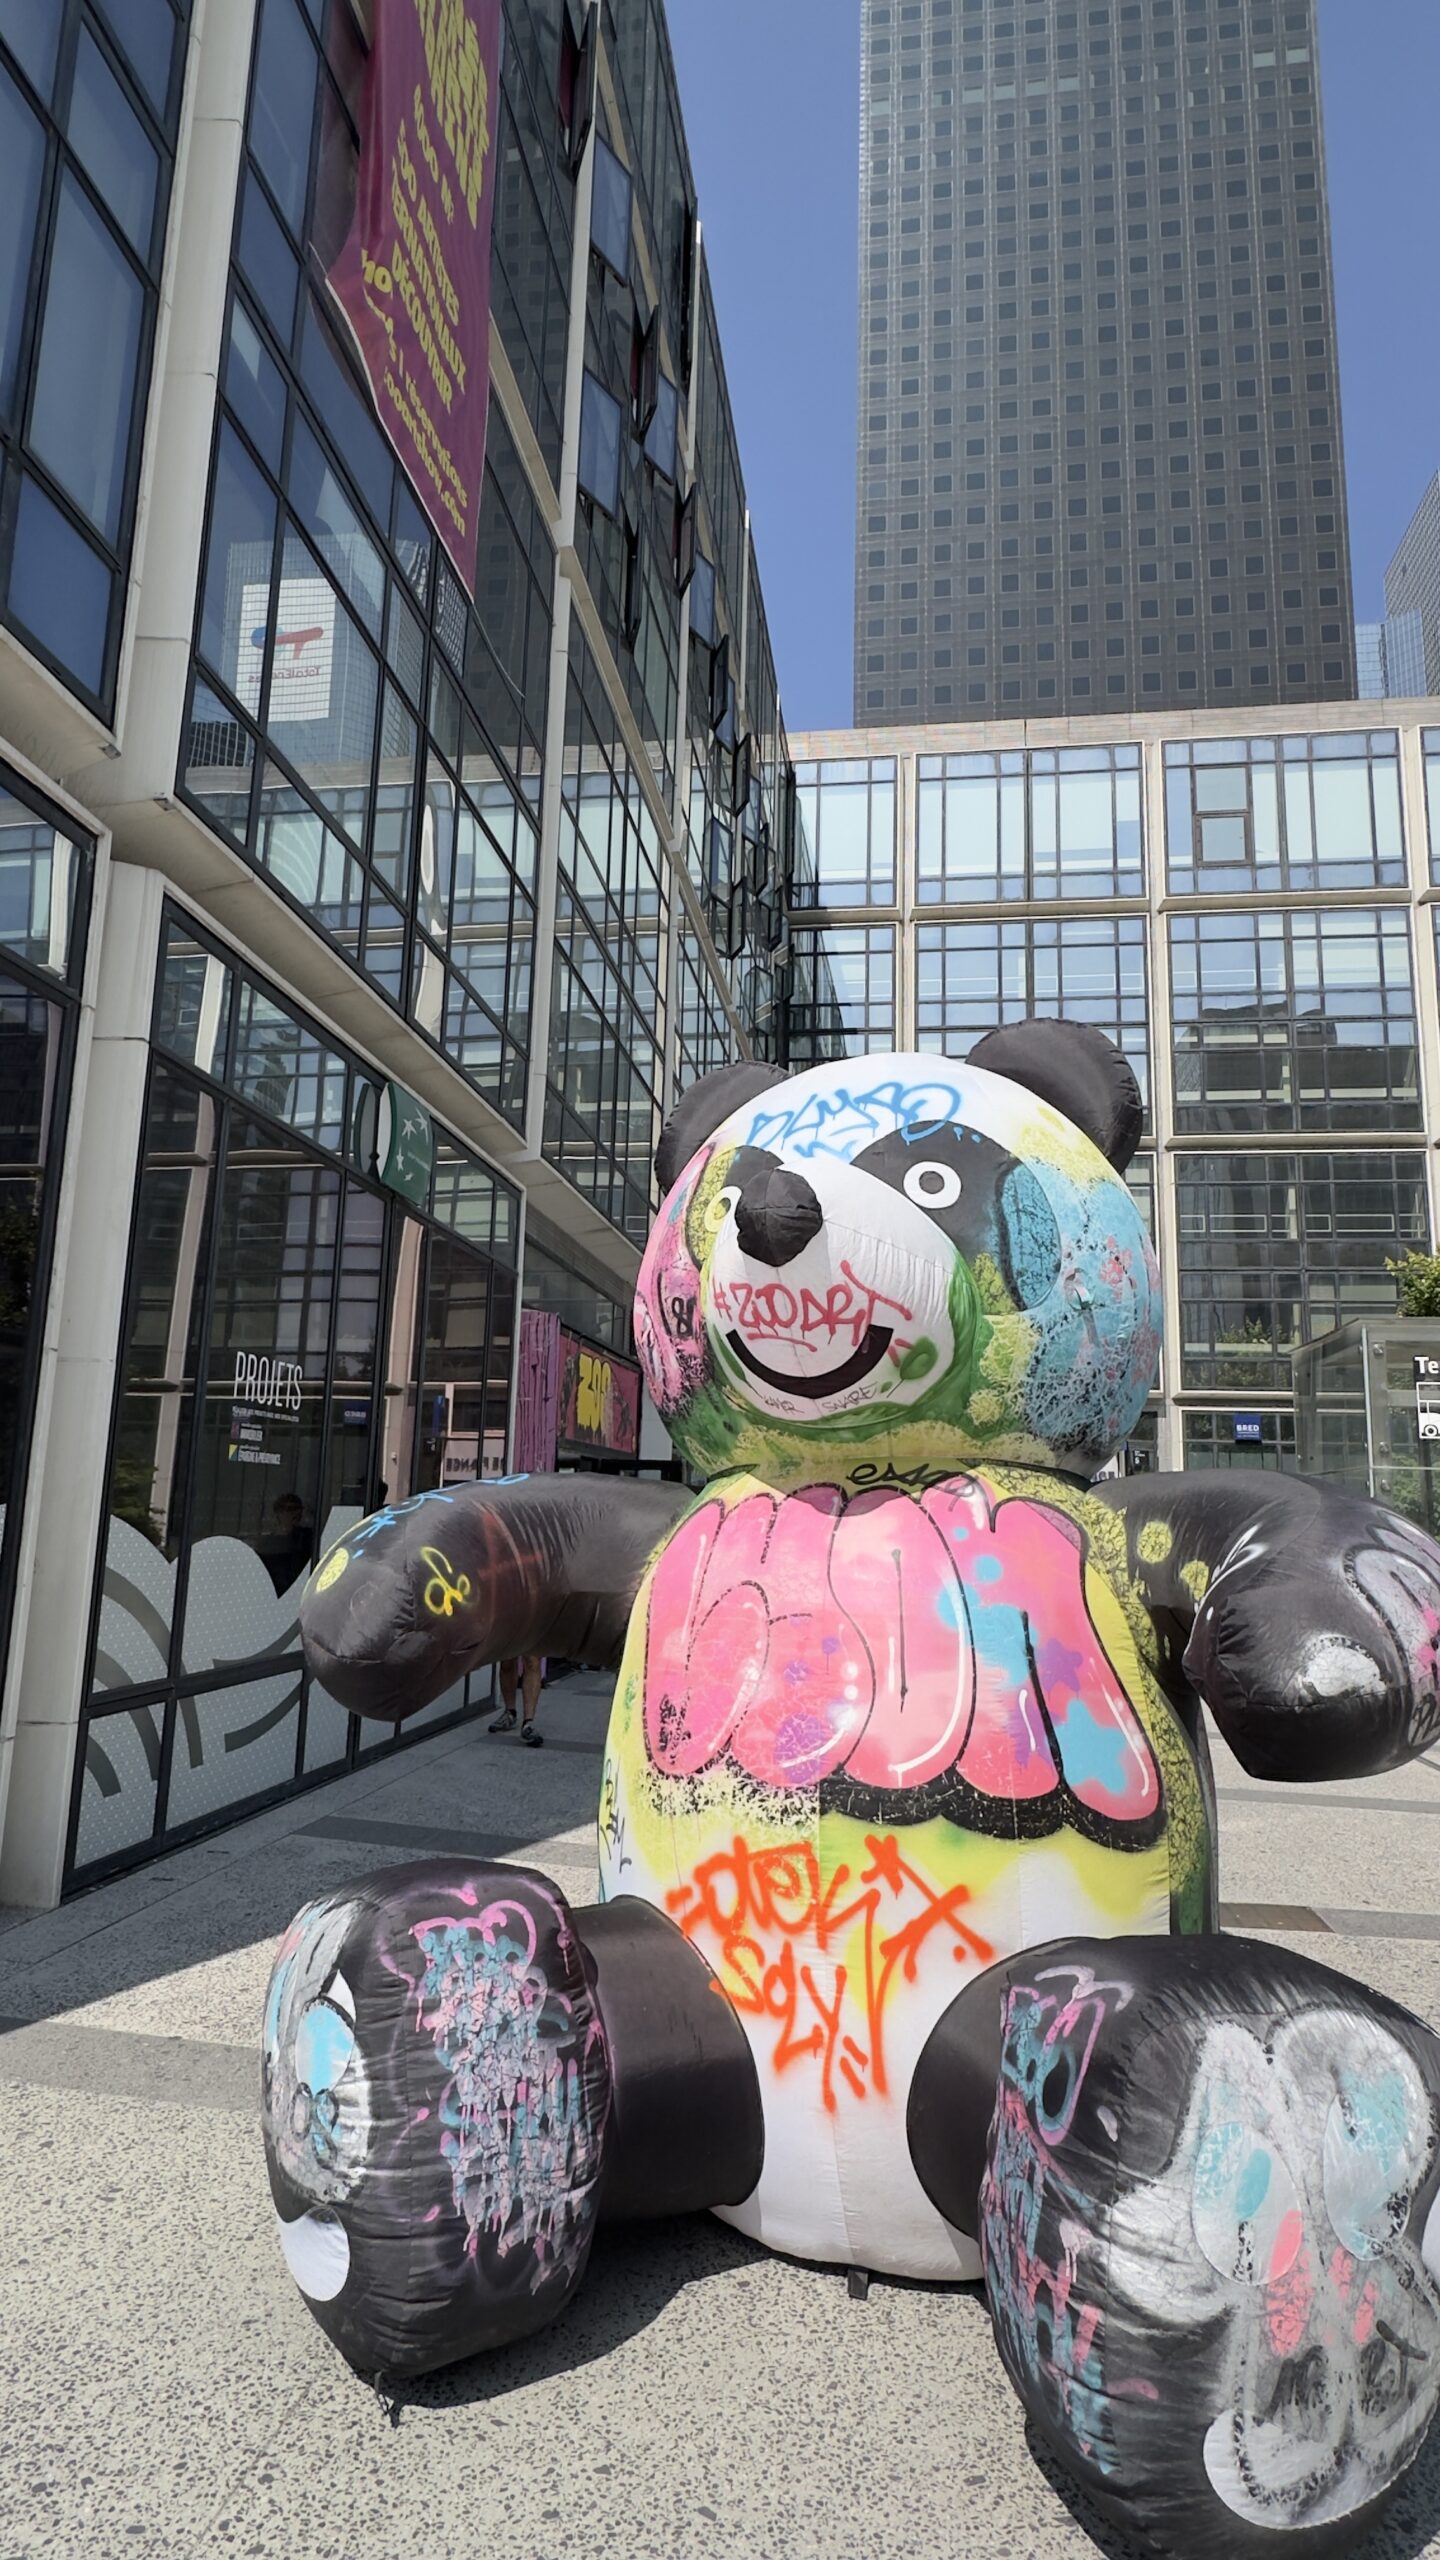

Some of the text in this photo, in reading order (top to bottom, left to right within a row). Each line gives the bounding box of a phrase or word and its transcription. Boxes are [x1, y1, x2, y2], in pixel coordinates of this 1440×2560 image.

[417, 192, 460, 327] ARTISTES
[391, 240, 453, 416] DÉCOUVRIR
[405, 370, 468, 509] réservations
[233, 1350, 303, 1411] PROJETS
[1414, 1356, 1440, 1374] Te
[1236, 1424, 1260, 1432] BRED
